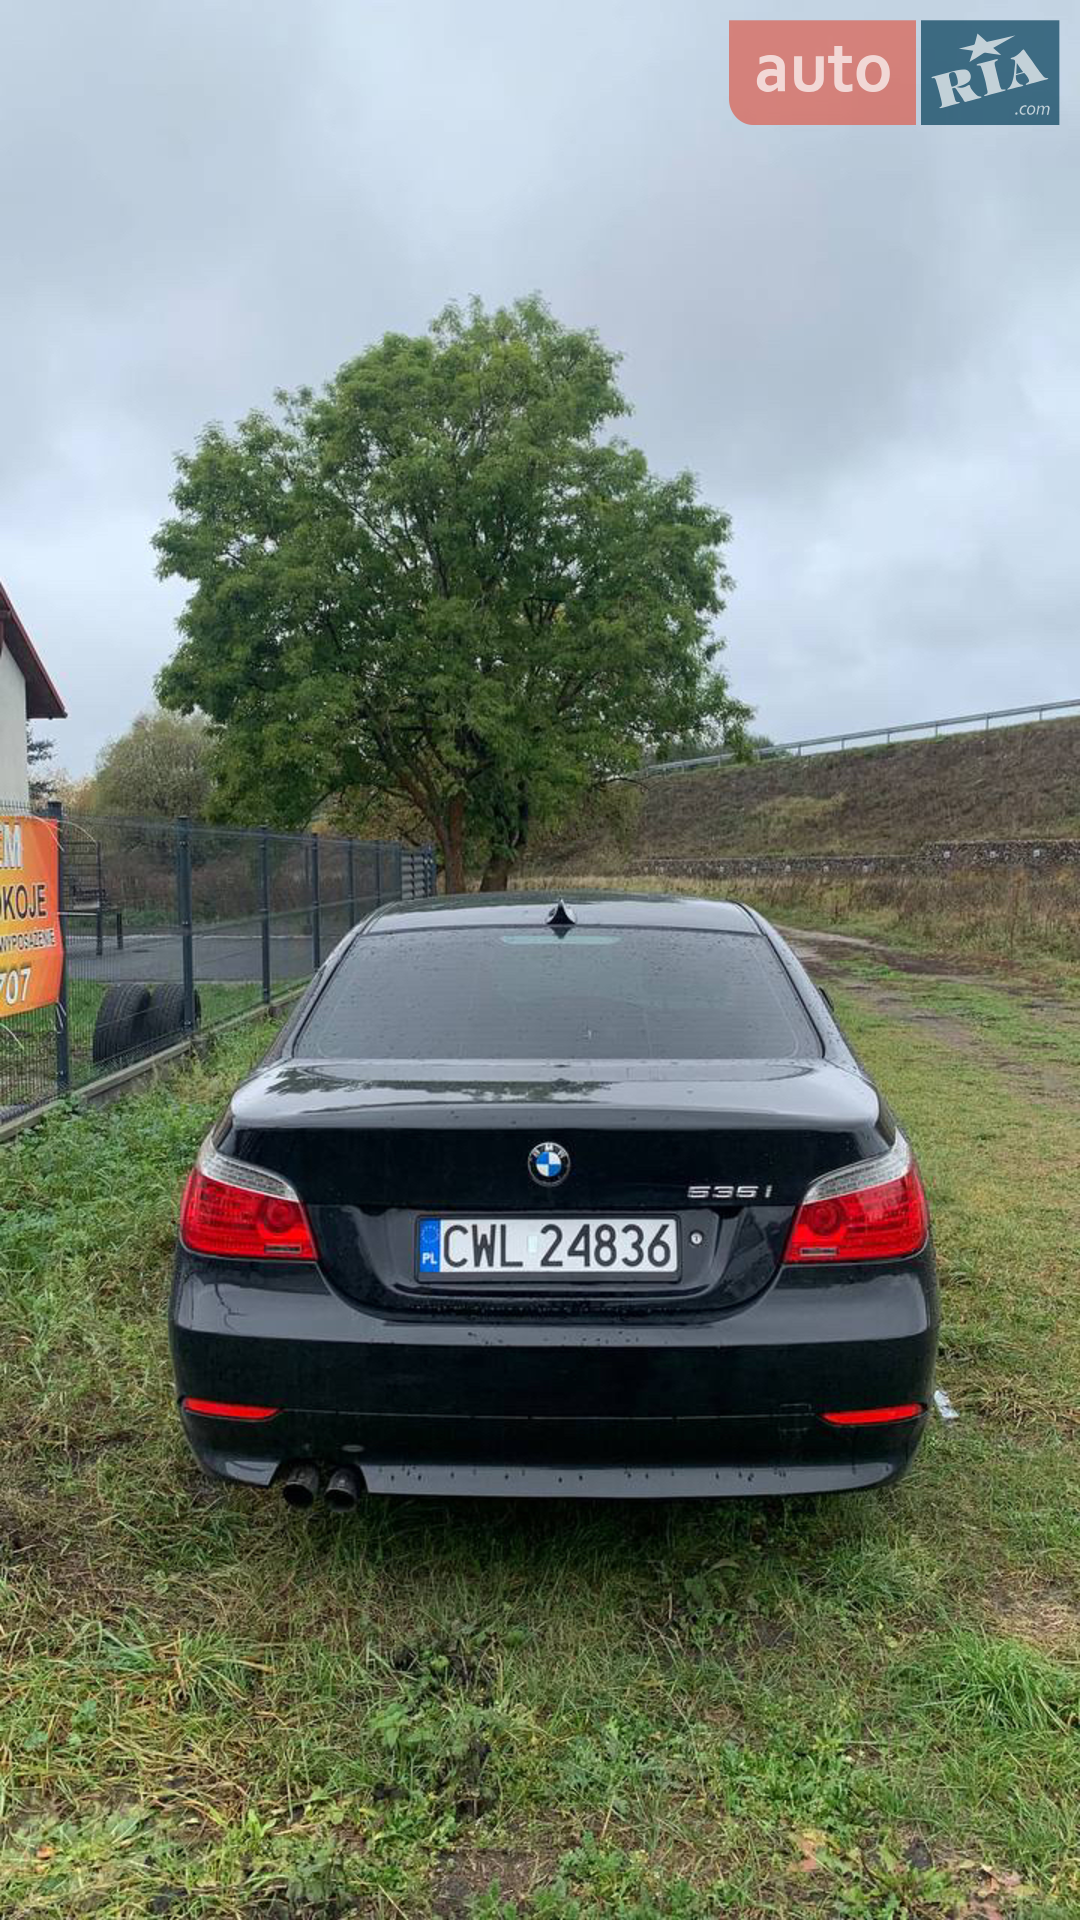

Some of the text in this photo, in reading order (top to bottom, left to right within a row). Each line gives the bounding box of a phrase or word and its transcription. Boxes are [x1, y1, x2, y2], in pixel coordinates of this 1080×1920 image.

[0, 884, 47, 920] KOJE
[422, 1252, 438, 1265] PL
[443, 1224, 671, 1268] CWL 24836
